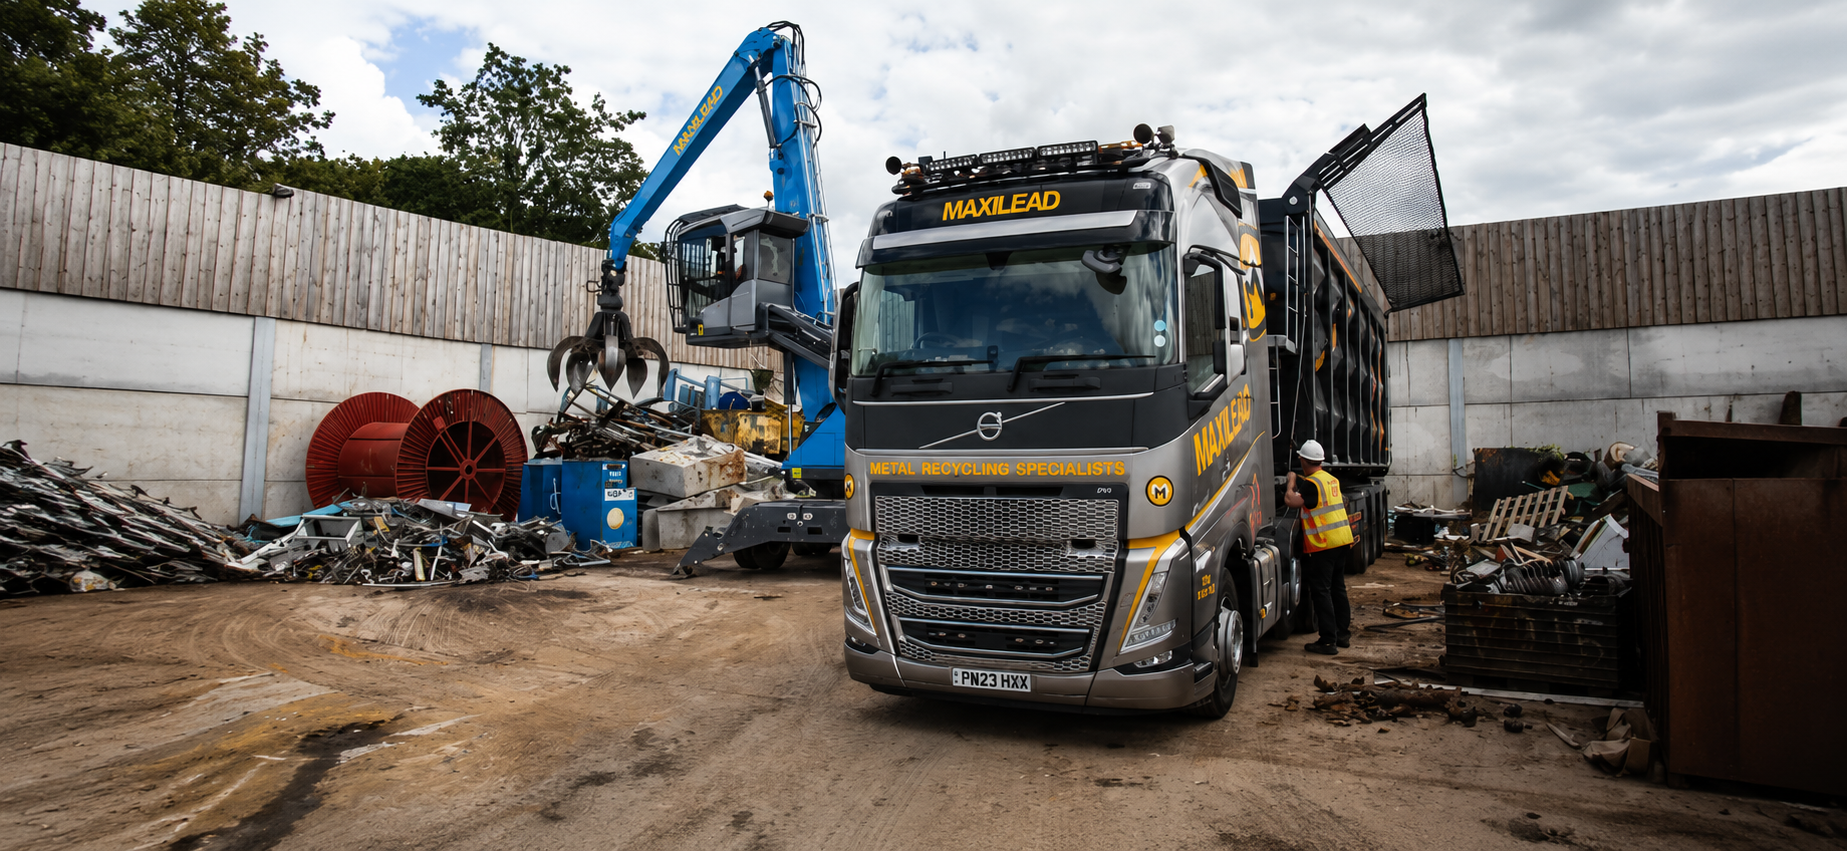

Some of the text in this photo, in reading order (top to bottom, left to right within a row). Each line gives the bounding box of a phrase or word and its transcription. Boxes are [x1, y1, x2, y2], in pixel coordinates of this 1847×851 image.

[942, 190, 1061, 221] MAXILEAD
[869, 461, 1125, 476] METAL RECYCLING SPECIALISTS
[961, 671, 1028, 689] PN23 HXX
